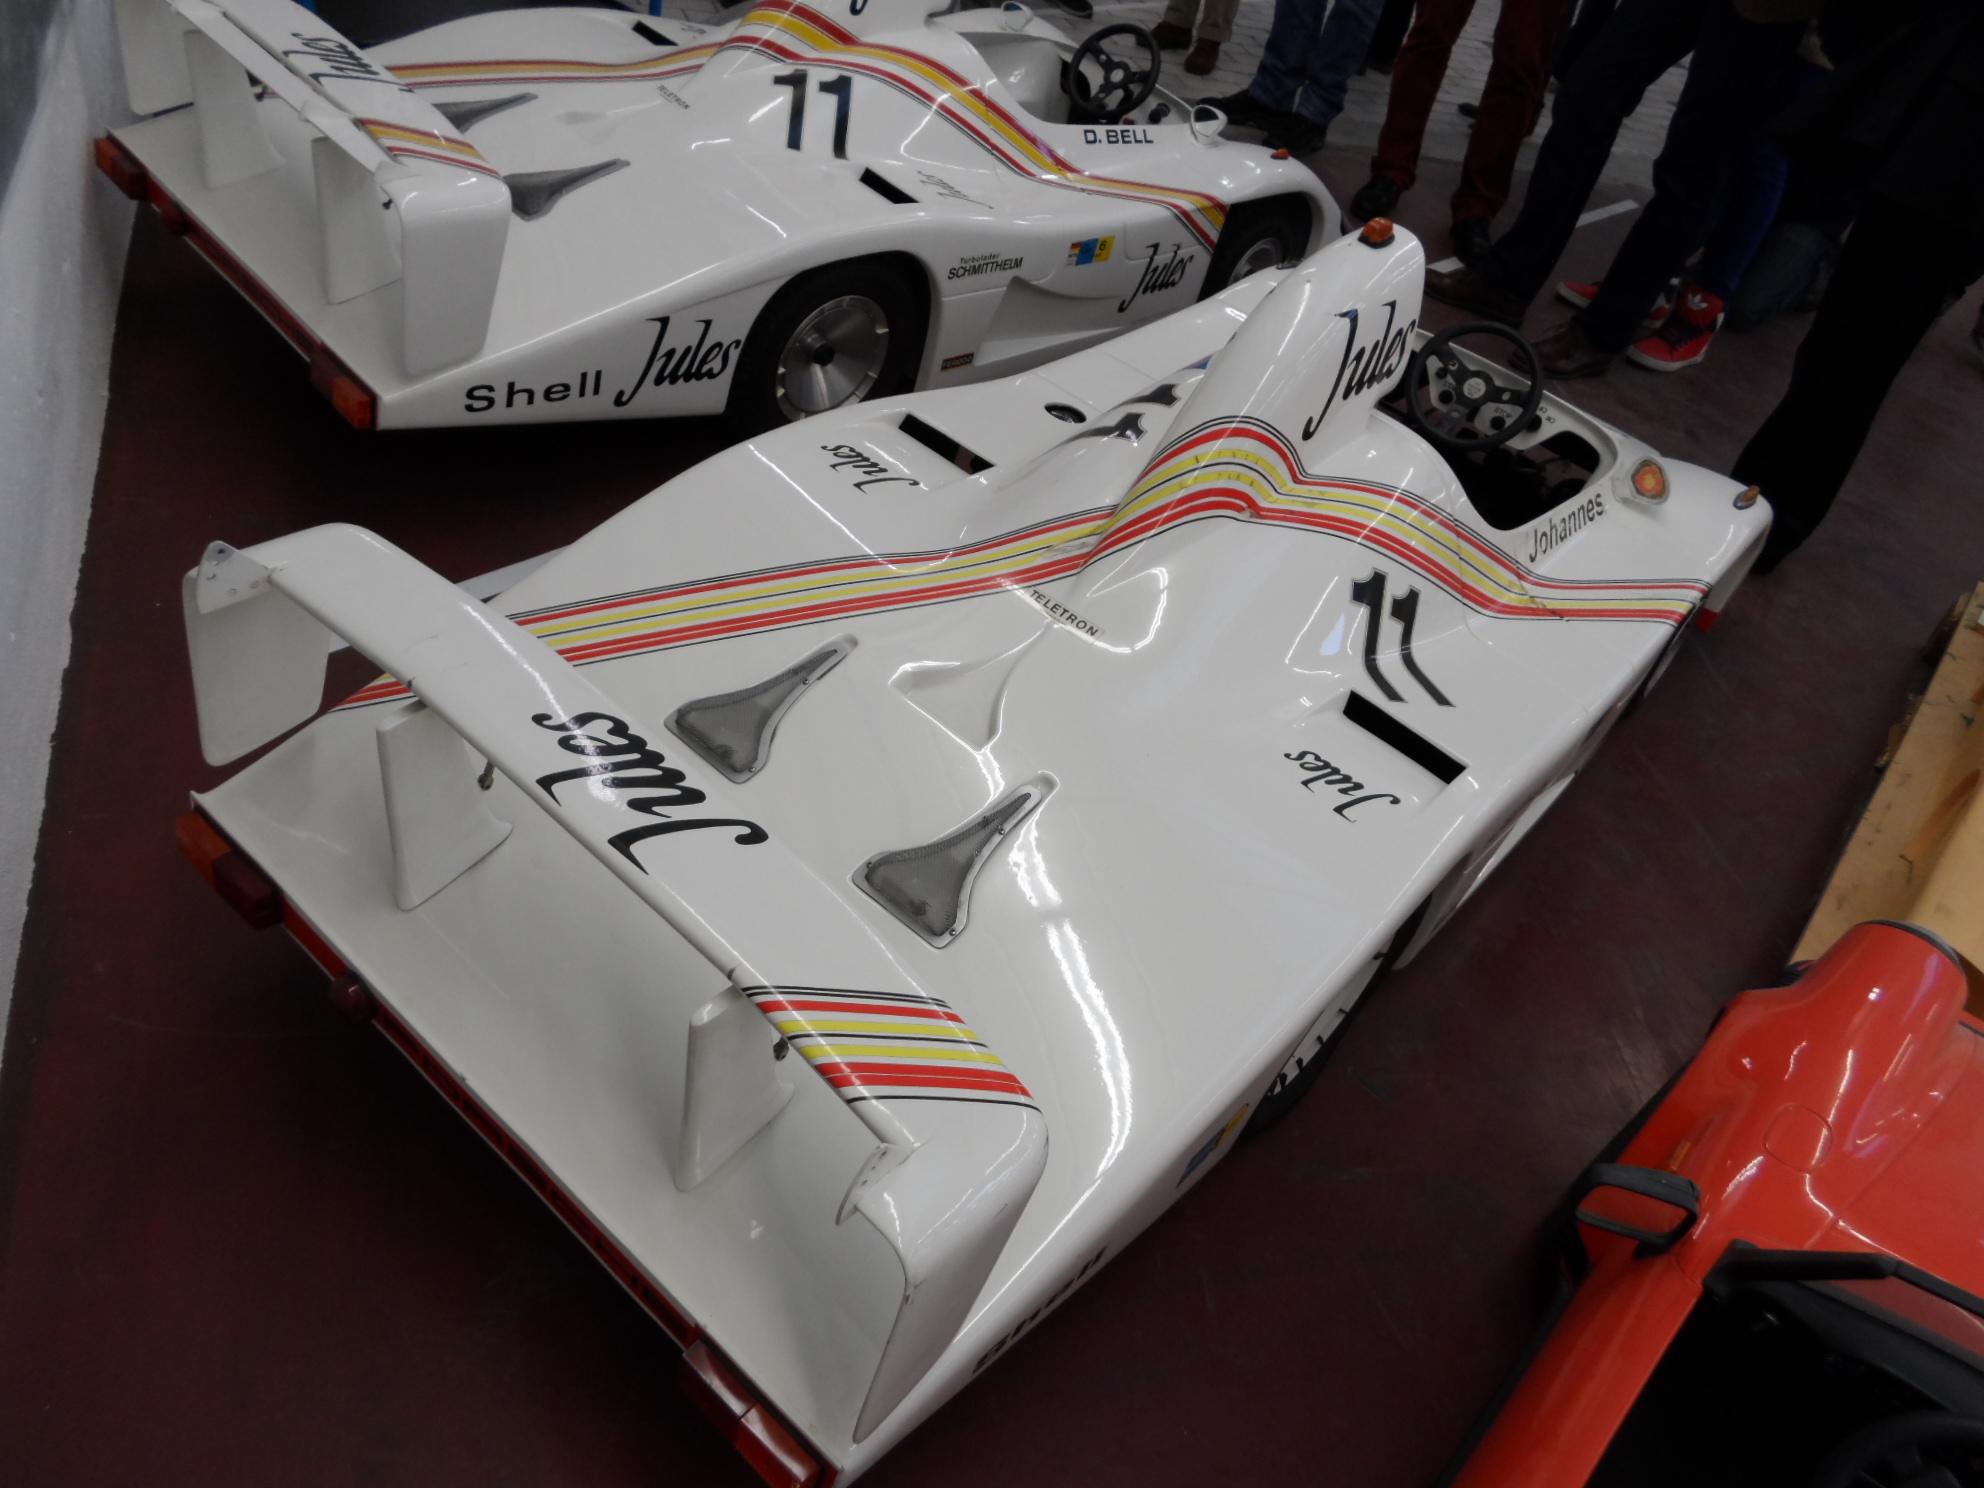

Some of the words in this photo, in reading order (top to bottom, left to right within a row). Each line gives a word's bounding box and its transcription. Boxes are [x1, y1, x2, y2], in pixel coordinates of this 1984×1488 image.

[283, 32, 415, 93] Jules
[773, 69, 852, 160] 11
[1083, 129, 1102, 144] D.
[1105, 129, 1154, 144] BELL
[948, 257, 1024, 280] SCHMITTHELM
[960, 253, 1000, 265] Turbolader
[1099, 240, 1108, 251] 6
[1116, 242, 1194, 313] Jules
[464, 369, 602, 413] Shell
[613, 315, 742, 407] Jules
[1301, 299, 1417, 441] Jules
[1494, 407, 1513, 419] STOP
[820, 444, 920, 494] Jules
[1529, 492, 1604, 563] Johannes
[1030, 589, 1099, 637] TELETRON
[1350, 567, 1457, 708] 11
[531, 711, 769, 876] Jules
[1283, 750, 1402, 824] Jules
